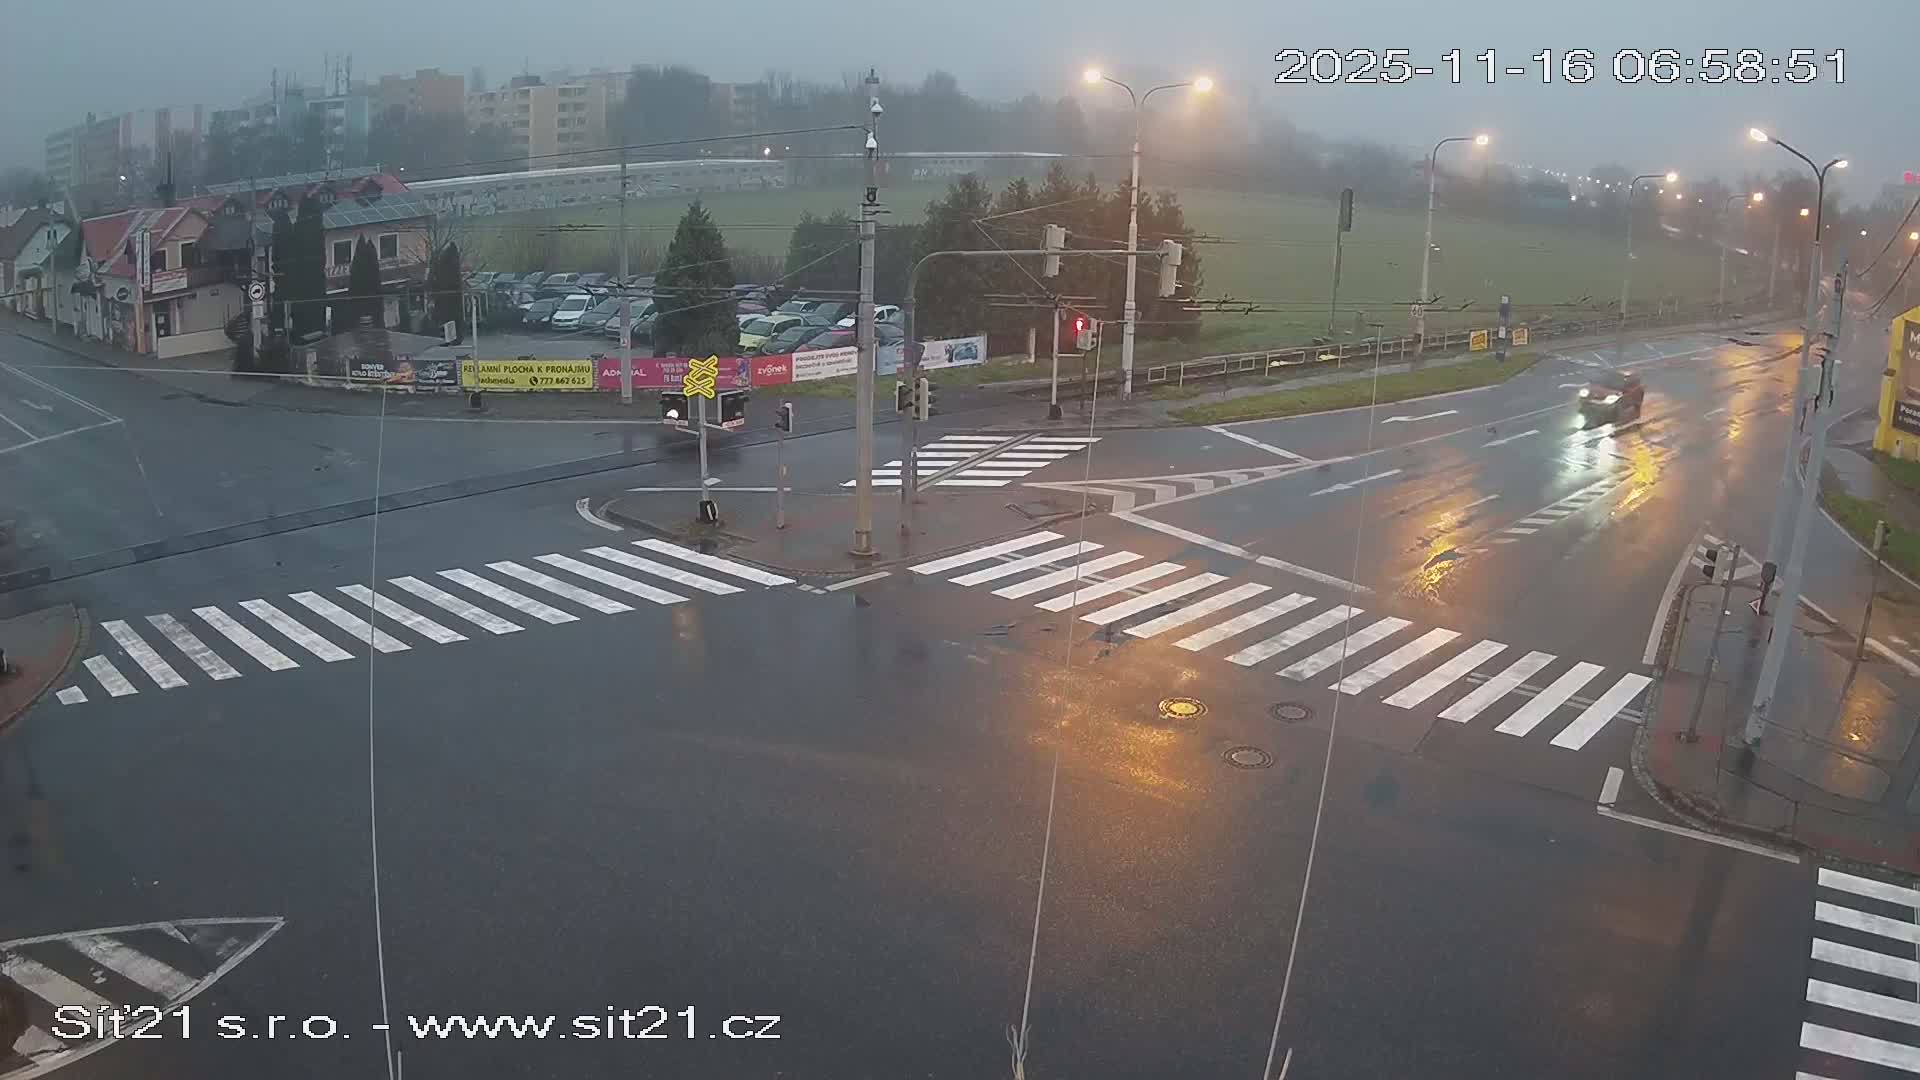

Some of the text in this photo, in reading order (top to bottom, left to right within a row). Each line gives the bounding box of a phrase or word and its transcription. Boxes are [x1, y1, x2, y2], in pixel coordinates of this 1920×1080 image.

[463, 364, 591, 374] RELAMNÍ PLOCHA K PRONÁJMU
